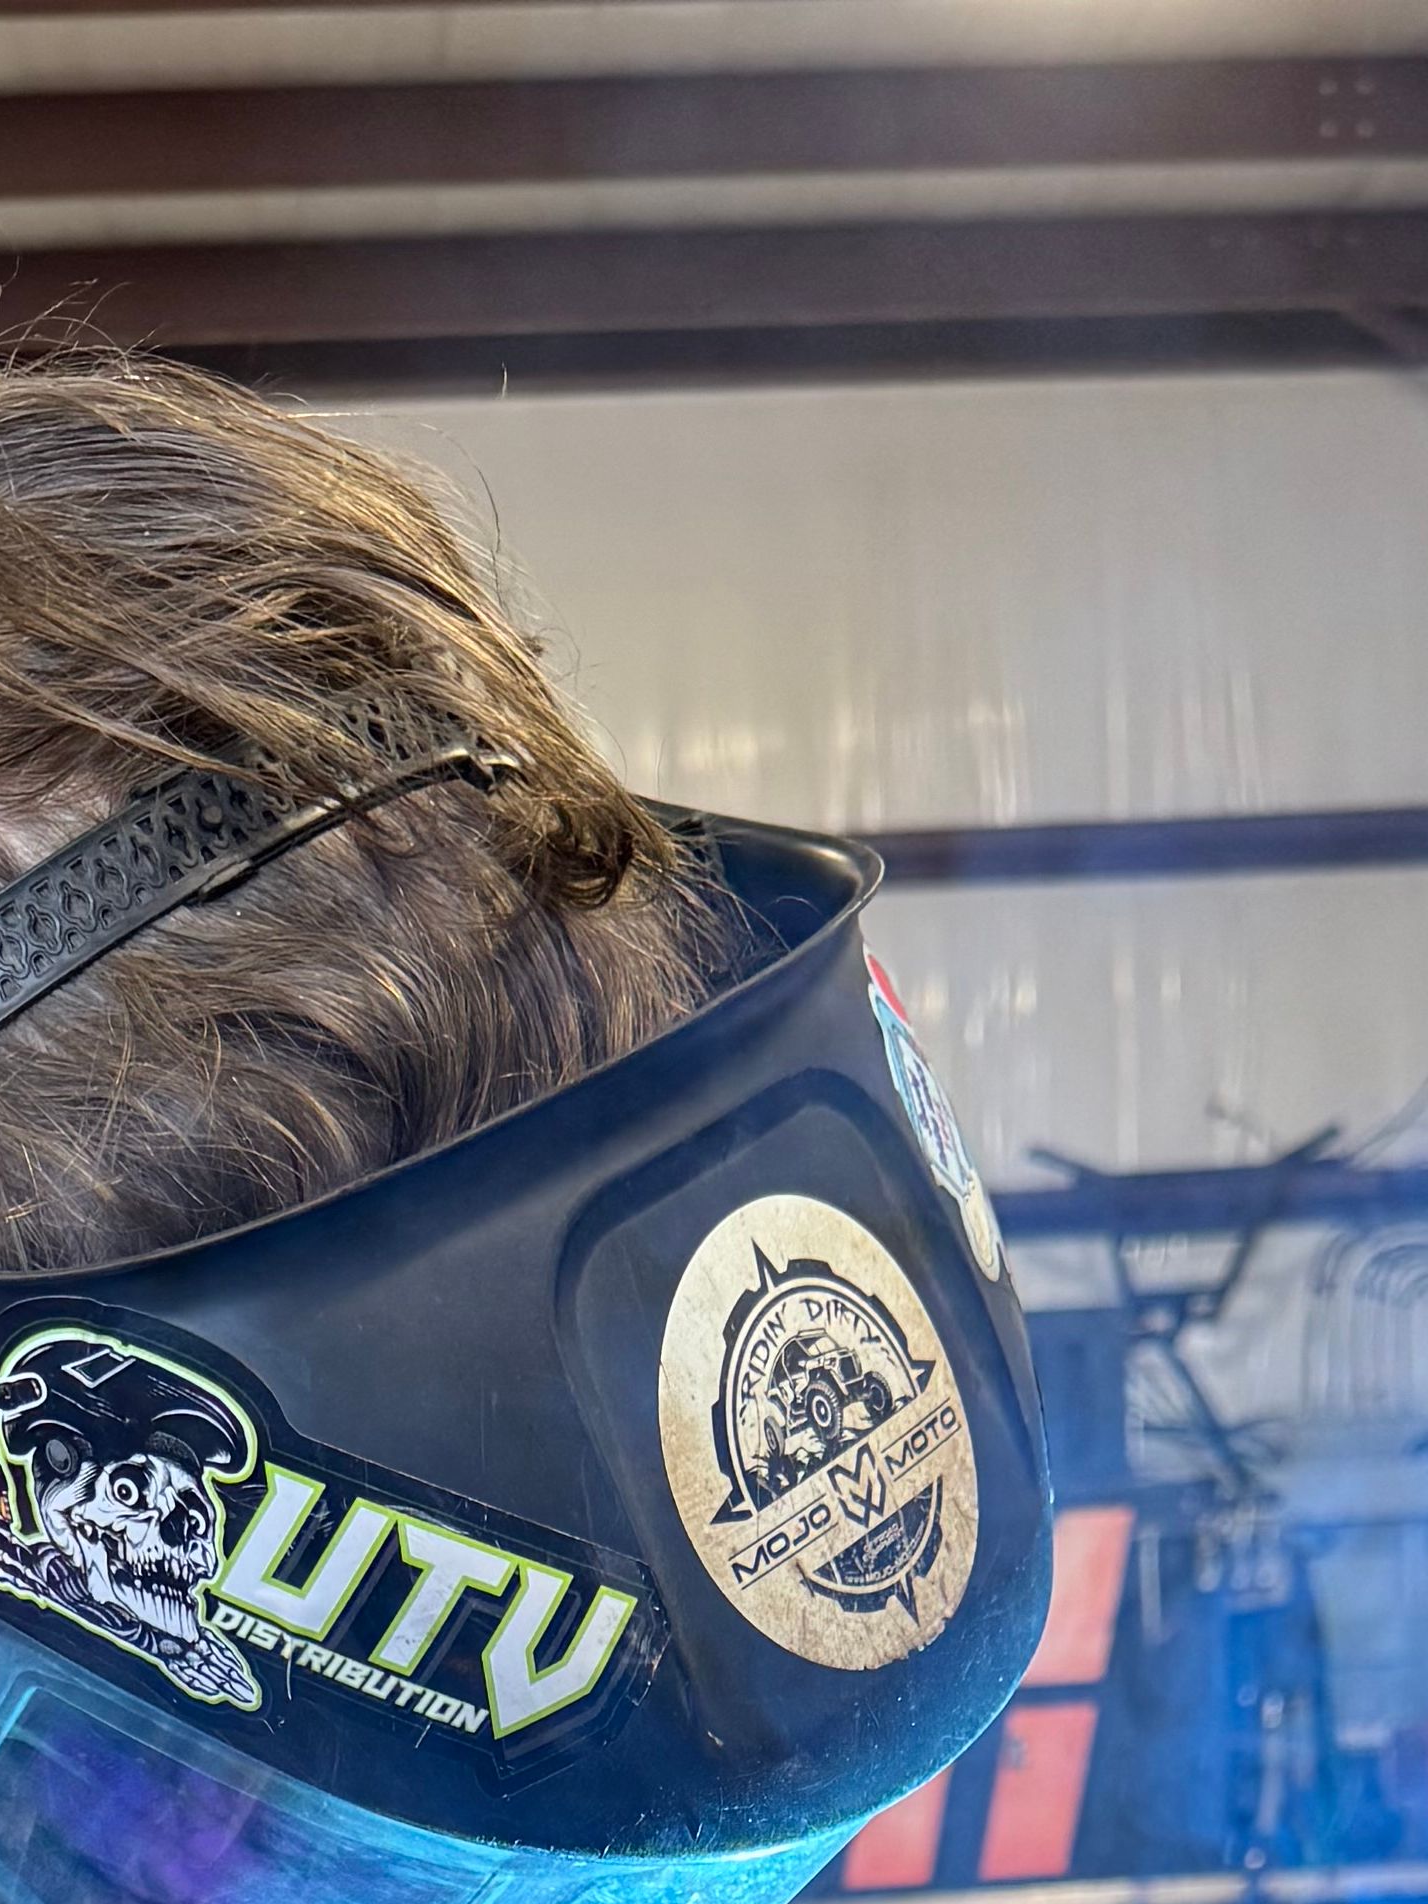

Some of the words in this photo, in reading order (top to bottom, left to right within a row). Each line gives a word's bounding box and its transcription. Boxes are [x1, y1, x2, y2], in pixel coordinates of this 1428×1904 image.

[741, 1301, 787, 1403] RIDIN'
[800, 1298, 881, 1344] DIRTY
[732, 1503, 831, 1584] MOJO
[885, 1406, 957, 1475] MOTO
[209, 1461, 638, 1740] UTV
[211, 1602, 490, 1733] DISTRIBUTION
